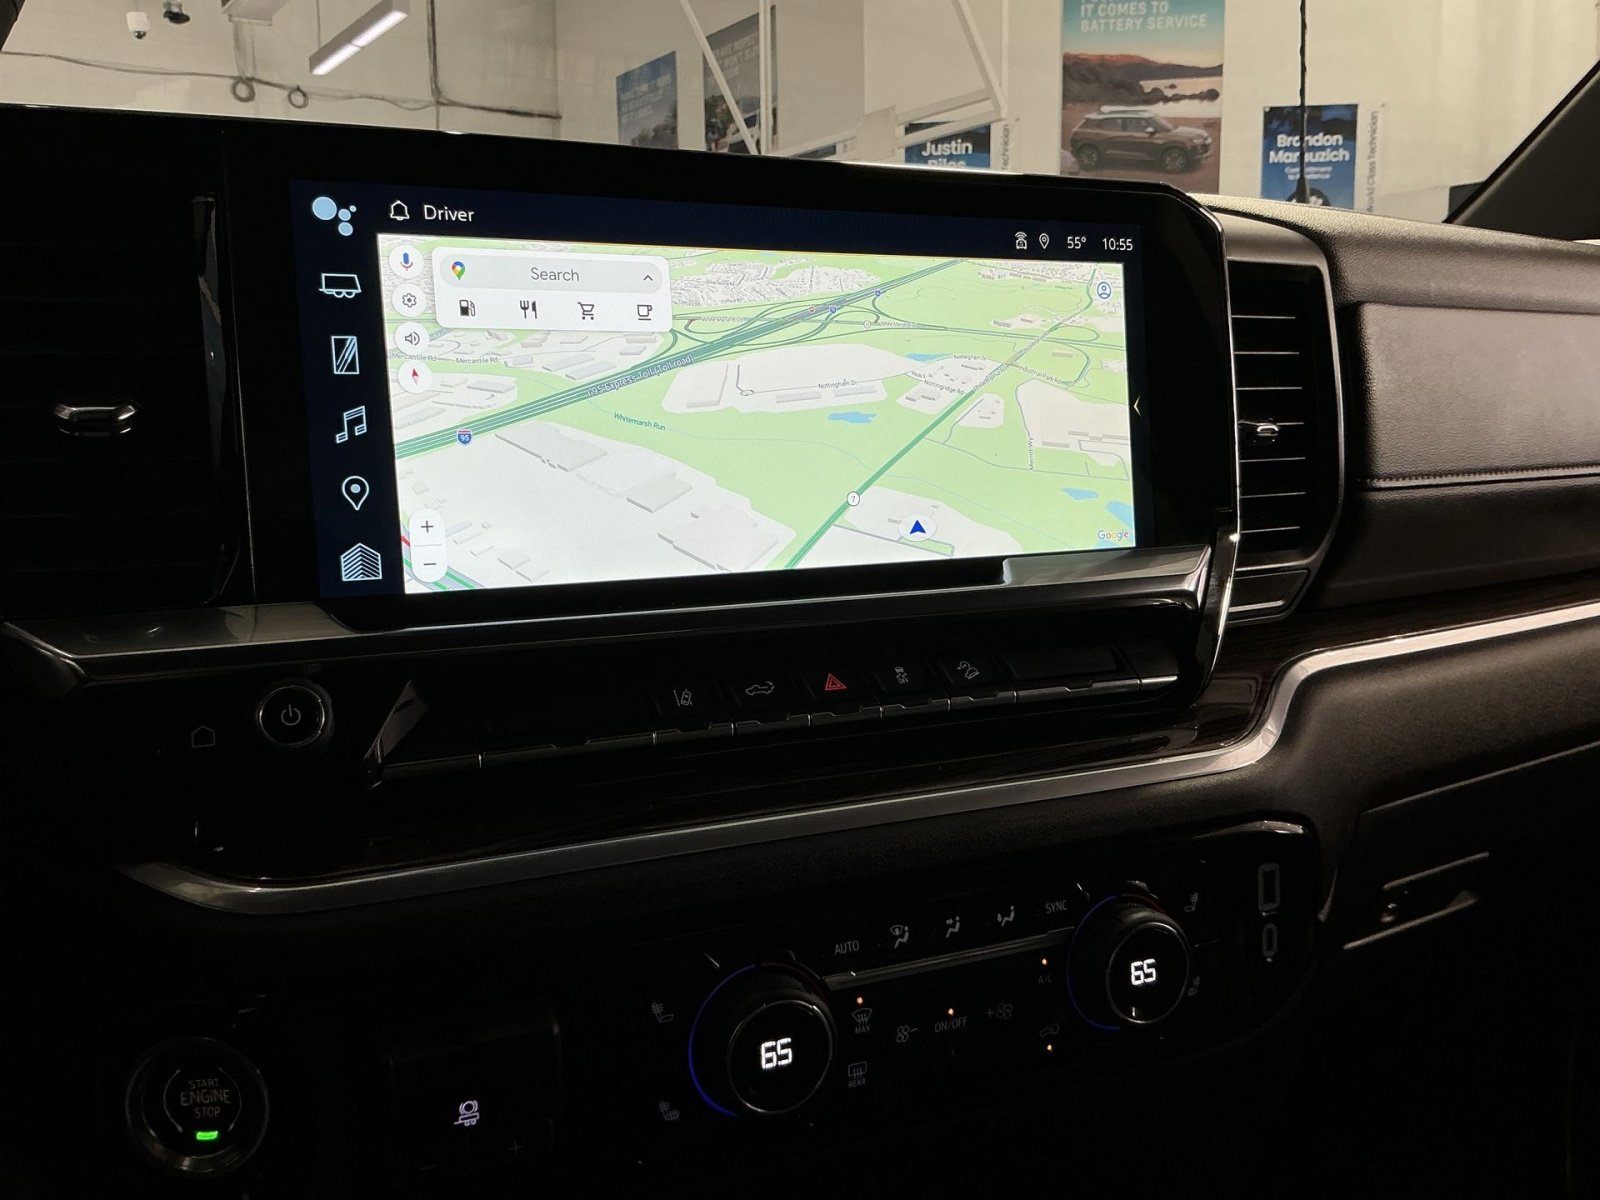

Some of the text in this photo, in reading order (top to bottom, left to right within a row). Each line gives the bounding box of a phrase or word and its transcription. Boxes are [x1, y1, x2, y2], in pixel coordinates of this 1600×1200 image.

[1080, 1, 1169, 17] IT COMES TO
[1080, 13, 1208, 33] BATTERY SERVICE
[921, 139, 973, 156] Justin
[1269, 148, 1350, 163] Maruzich
[423, 204, 475, 222] Driver
[1066, 236, 1134, 251] 55° 10:55
[530, 267, 580, 282] Search
[391, 353, 427, 361] Mercantile
[604, 375, 637, 391] Express
[639, 369, 654, 379] Toll
[1042, 372, 1053, 381] Park
[818, 380, 850, 389] Nottingham
[924, 379, 956, 394] Nottingridge
[614, 411, 666, 431] Whitemarsh Run
[460, 434, 470, 442] 95
[1097, 529, 1129, 541] Google
[1045, 900, 1068, 914] SYNC
[834, 940, 860, 955] AUTO
[1130, 958, 1156, 986] 65
[854, 1025, 870, 1034] MAX
[934, 1017, 967, 1033] ON/OFF
[761, 1037, 793, 1070] 65
[187, 1078, 219, 1090] START
[848, 1077, 866, 1088] REAR
[180, 1088, 231, 1107] ENGINE
[194, 1106, 220, 1119] STOP
